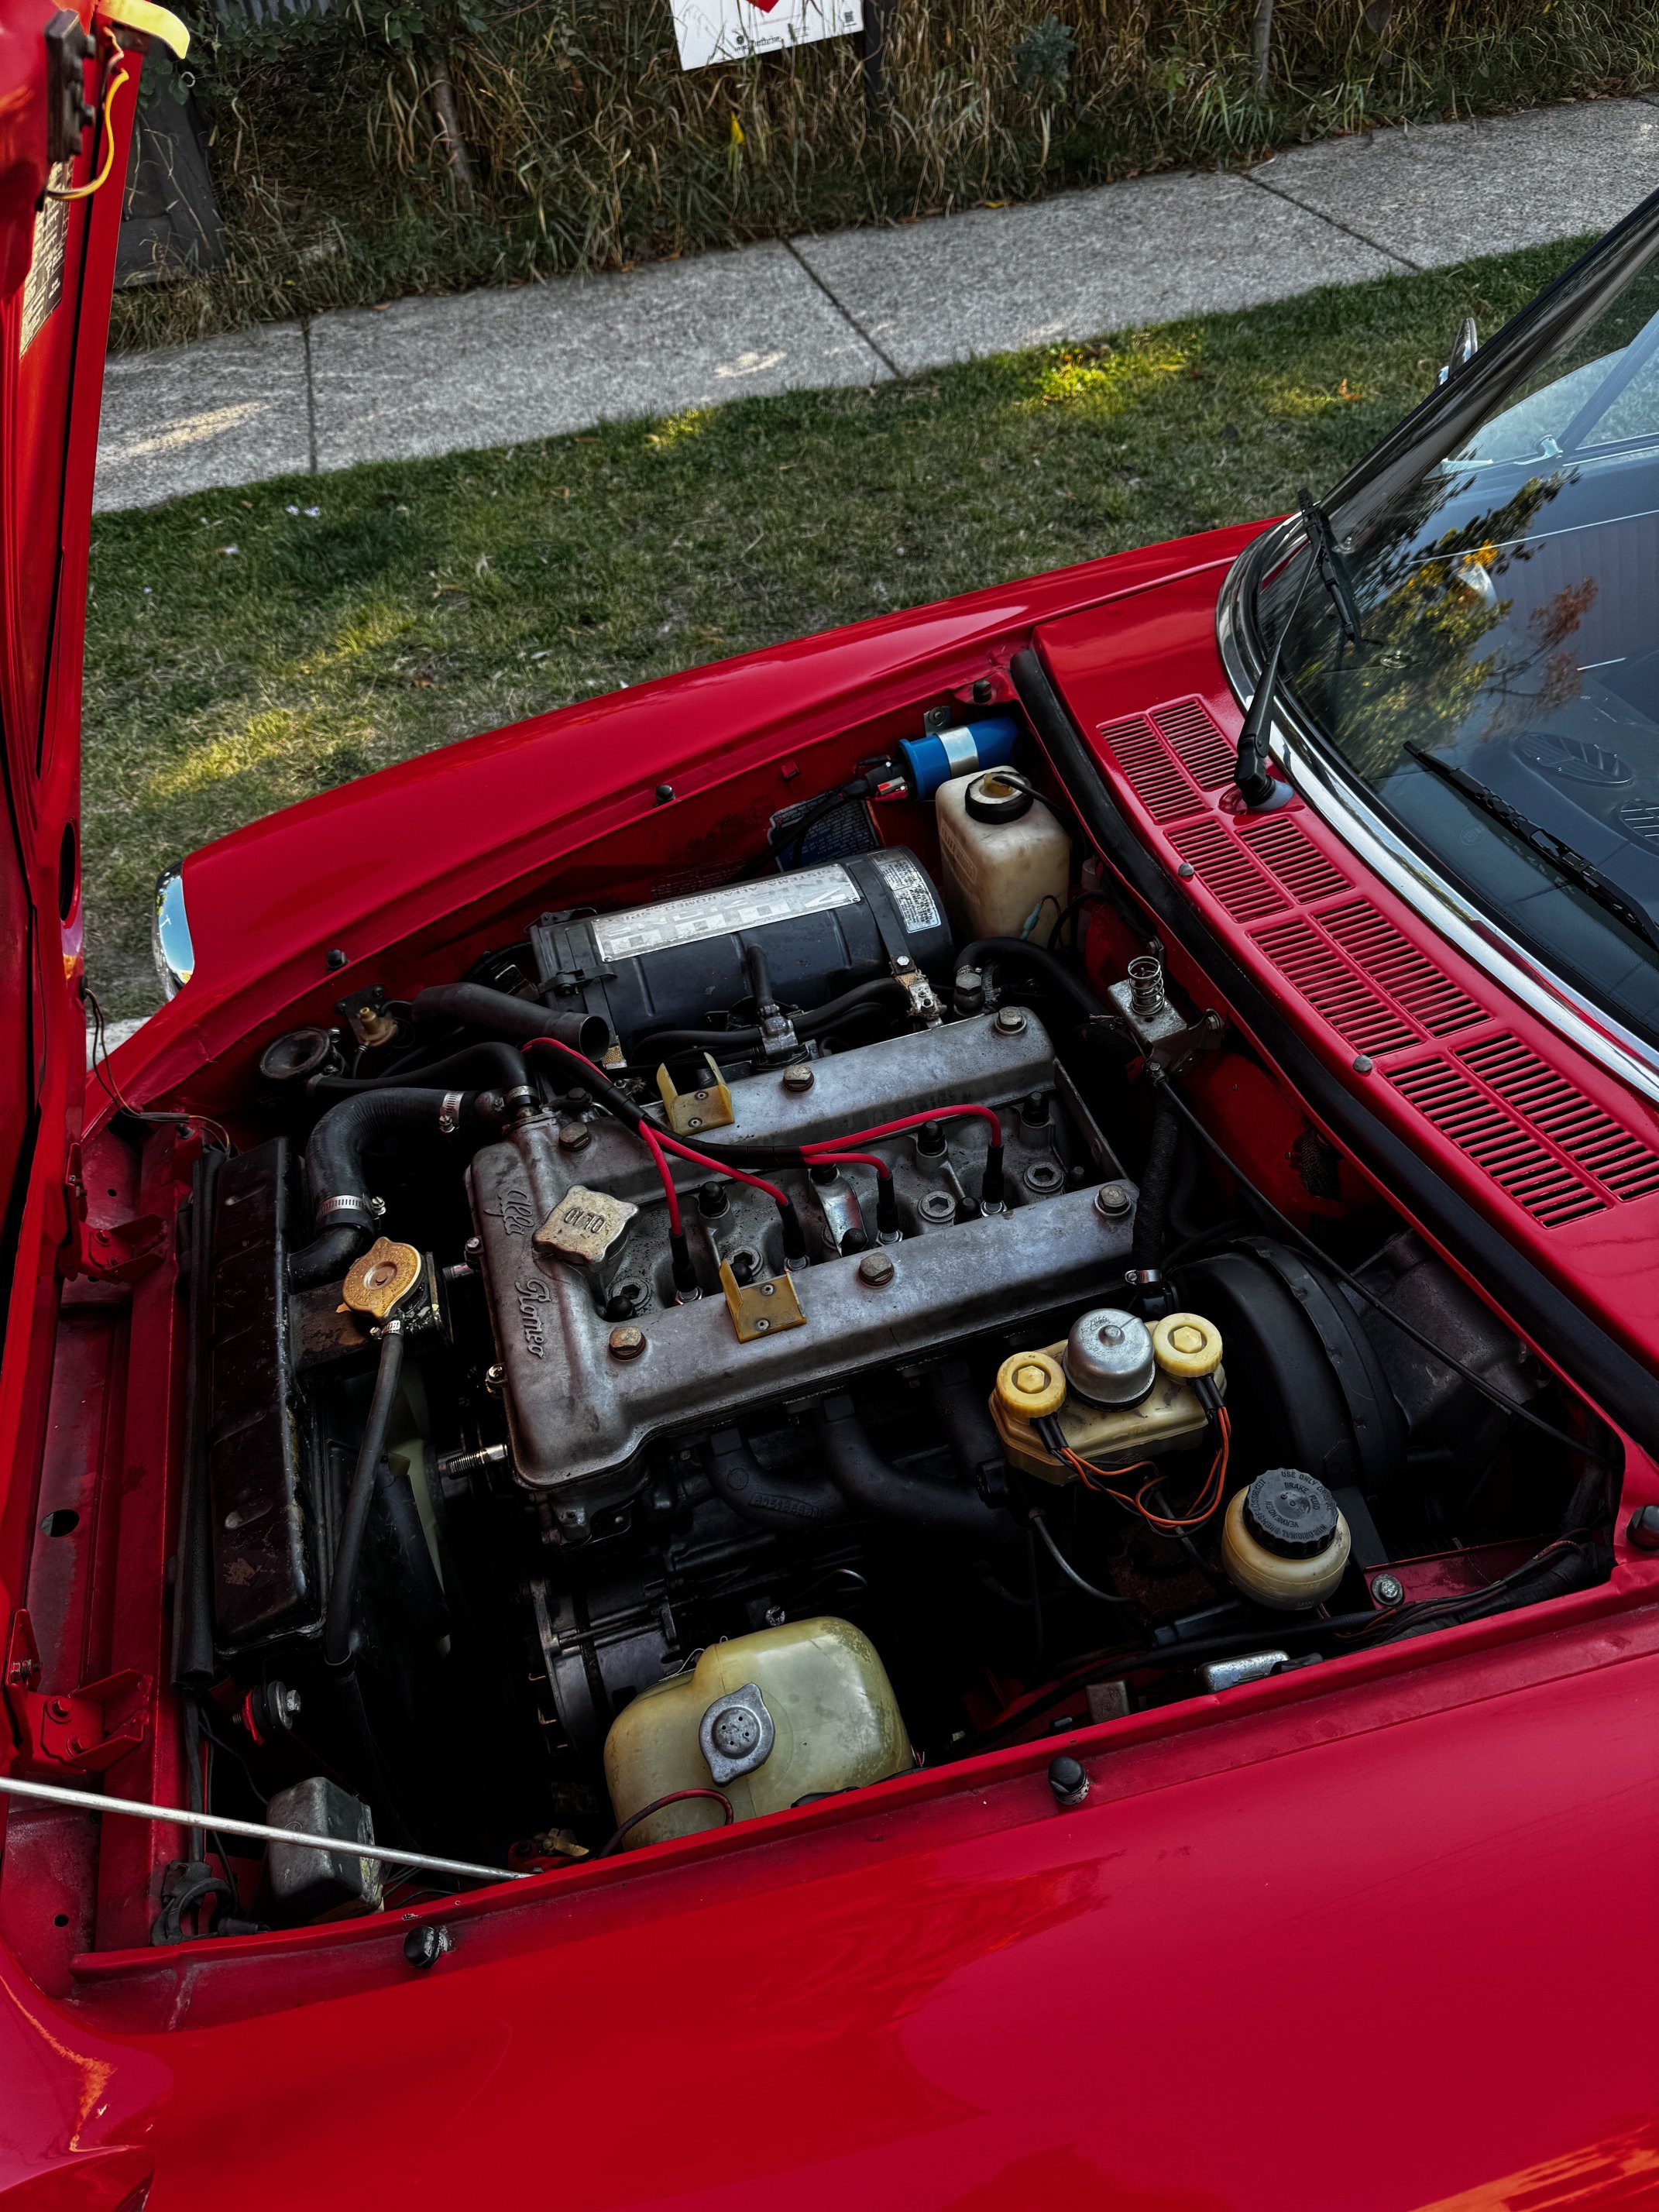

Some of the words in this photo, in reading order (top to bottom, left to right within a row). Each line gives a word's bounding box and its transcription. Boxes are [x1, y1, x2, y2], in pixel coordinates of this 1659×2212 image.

[663, 895, 717, 912] ROMEO
[722, 885, 759, 898] ALFA
[483, 1188, 534, 1235] Alfa
[563, 1207, 607, 1234] OLIO
[514, 1277, 551, 1359] Romeo
[1299, 1474, 1317, 1486] ONLY
[1283, 1482, 1310, 1494] BRAKE
[1309, 1494, 1321, 1511] FLUID
[1265, 1500, 1300, 1529] VERWENDEN
